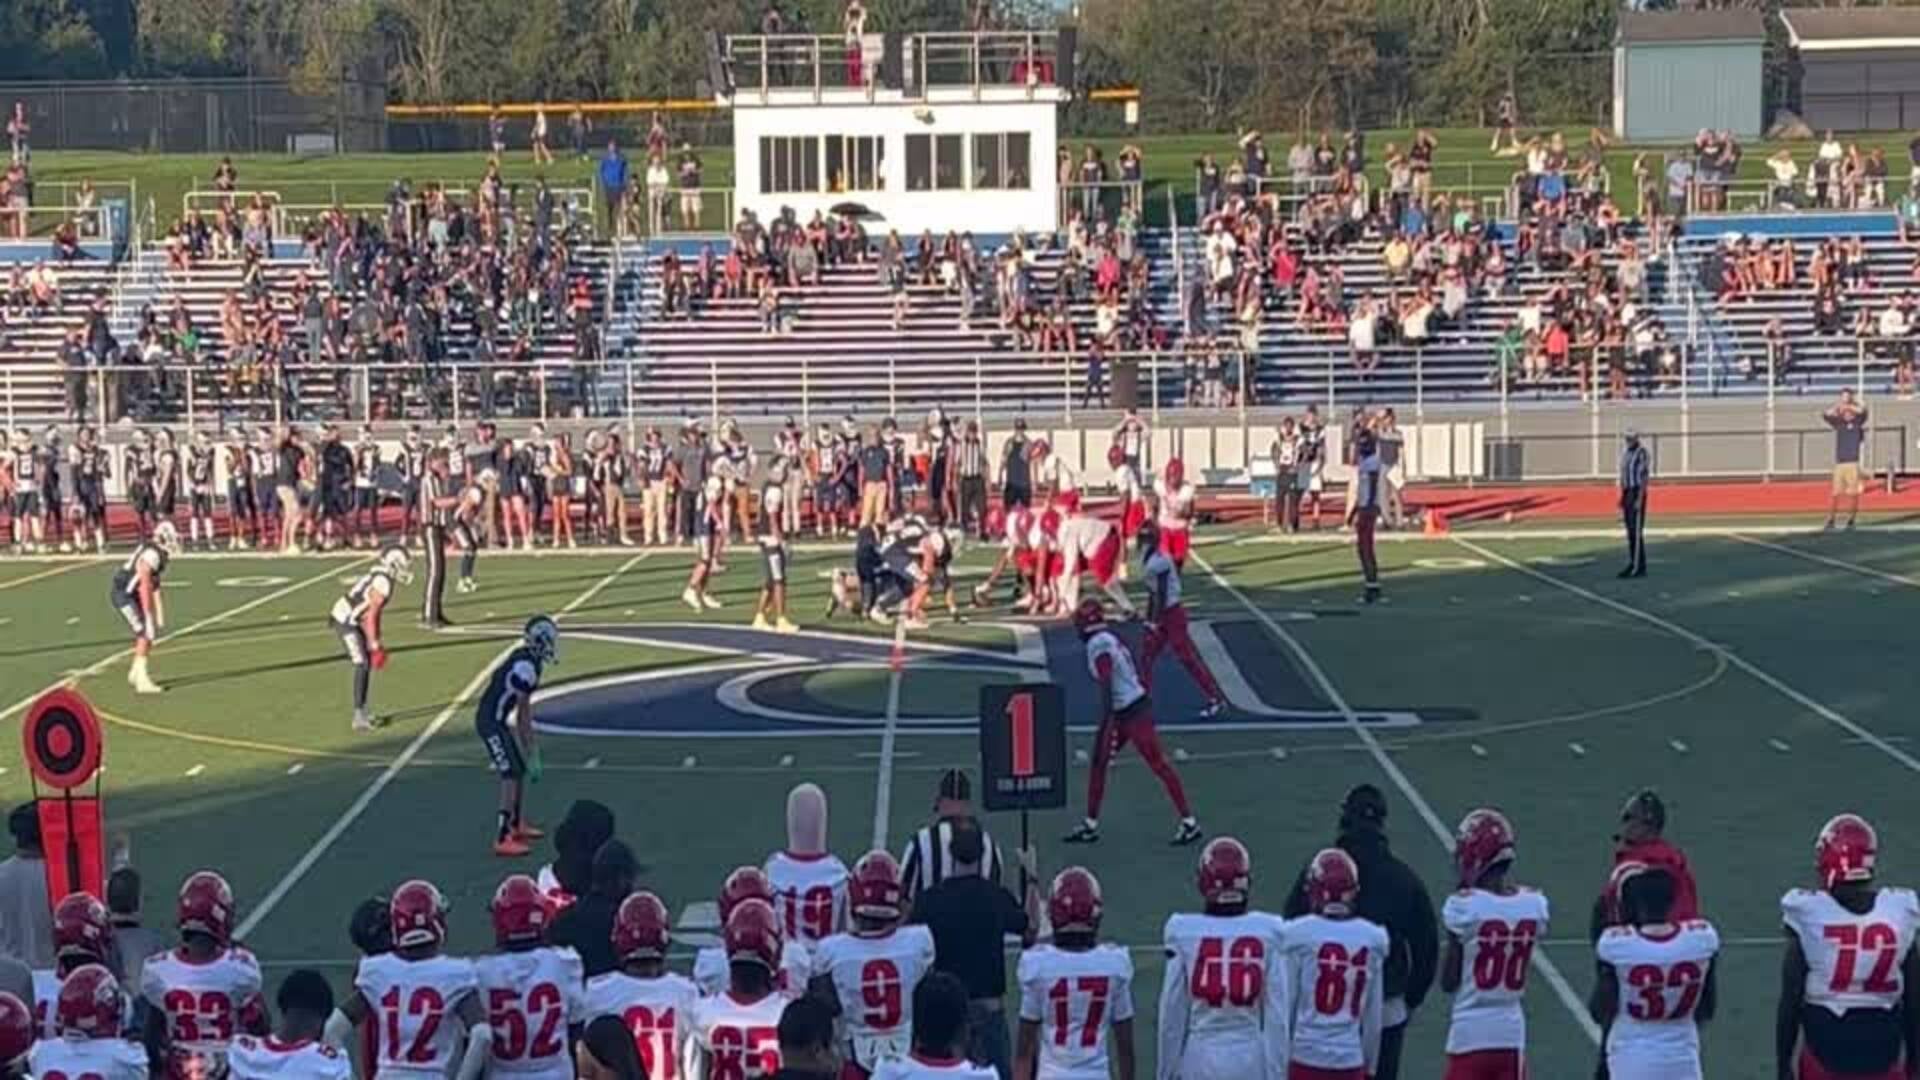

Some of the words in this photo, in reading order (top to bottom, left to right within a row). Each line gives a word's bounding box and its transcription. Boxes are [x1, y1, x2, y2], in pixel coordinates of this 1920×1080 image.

[1005, 692, 1034, 775] 1
[785, 886, 832, 939] 19
[1190, 936, 1264, 1009] 46
[1315, 942, 1369, 1019] 81
[1473, 919, 1536, 991] 88
[1823, 924, 1899, 993] 72
[381, 985, 444, 1064] 12
[489, 982, 563, 1062] 52
[861, 959, 902, 1030] 9
[1048, 976, 1108, 1048] 17
[711, 1026, 780, 1080] 85
